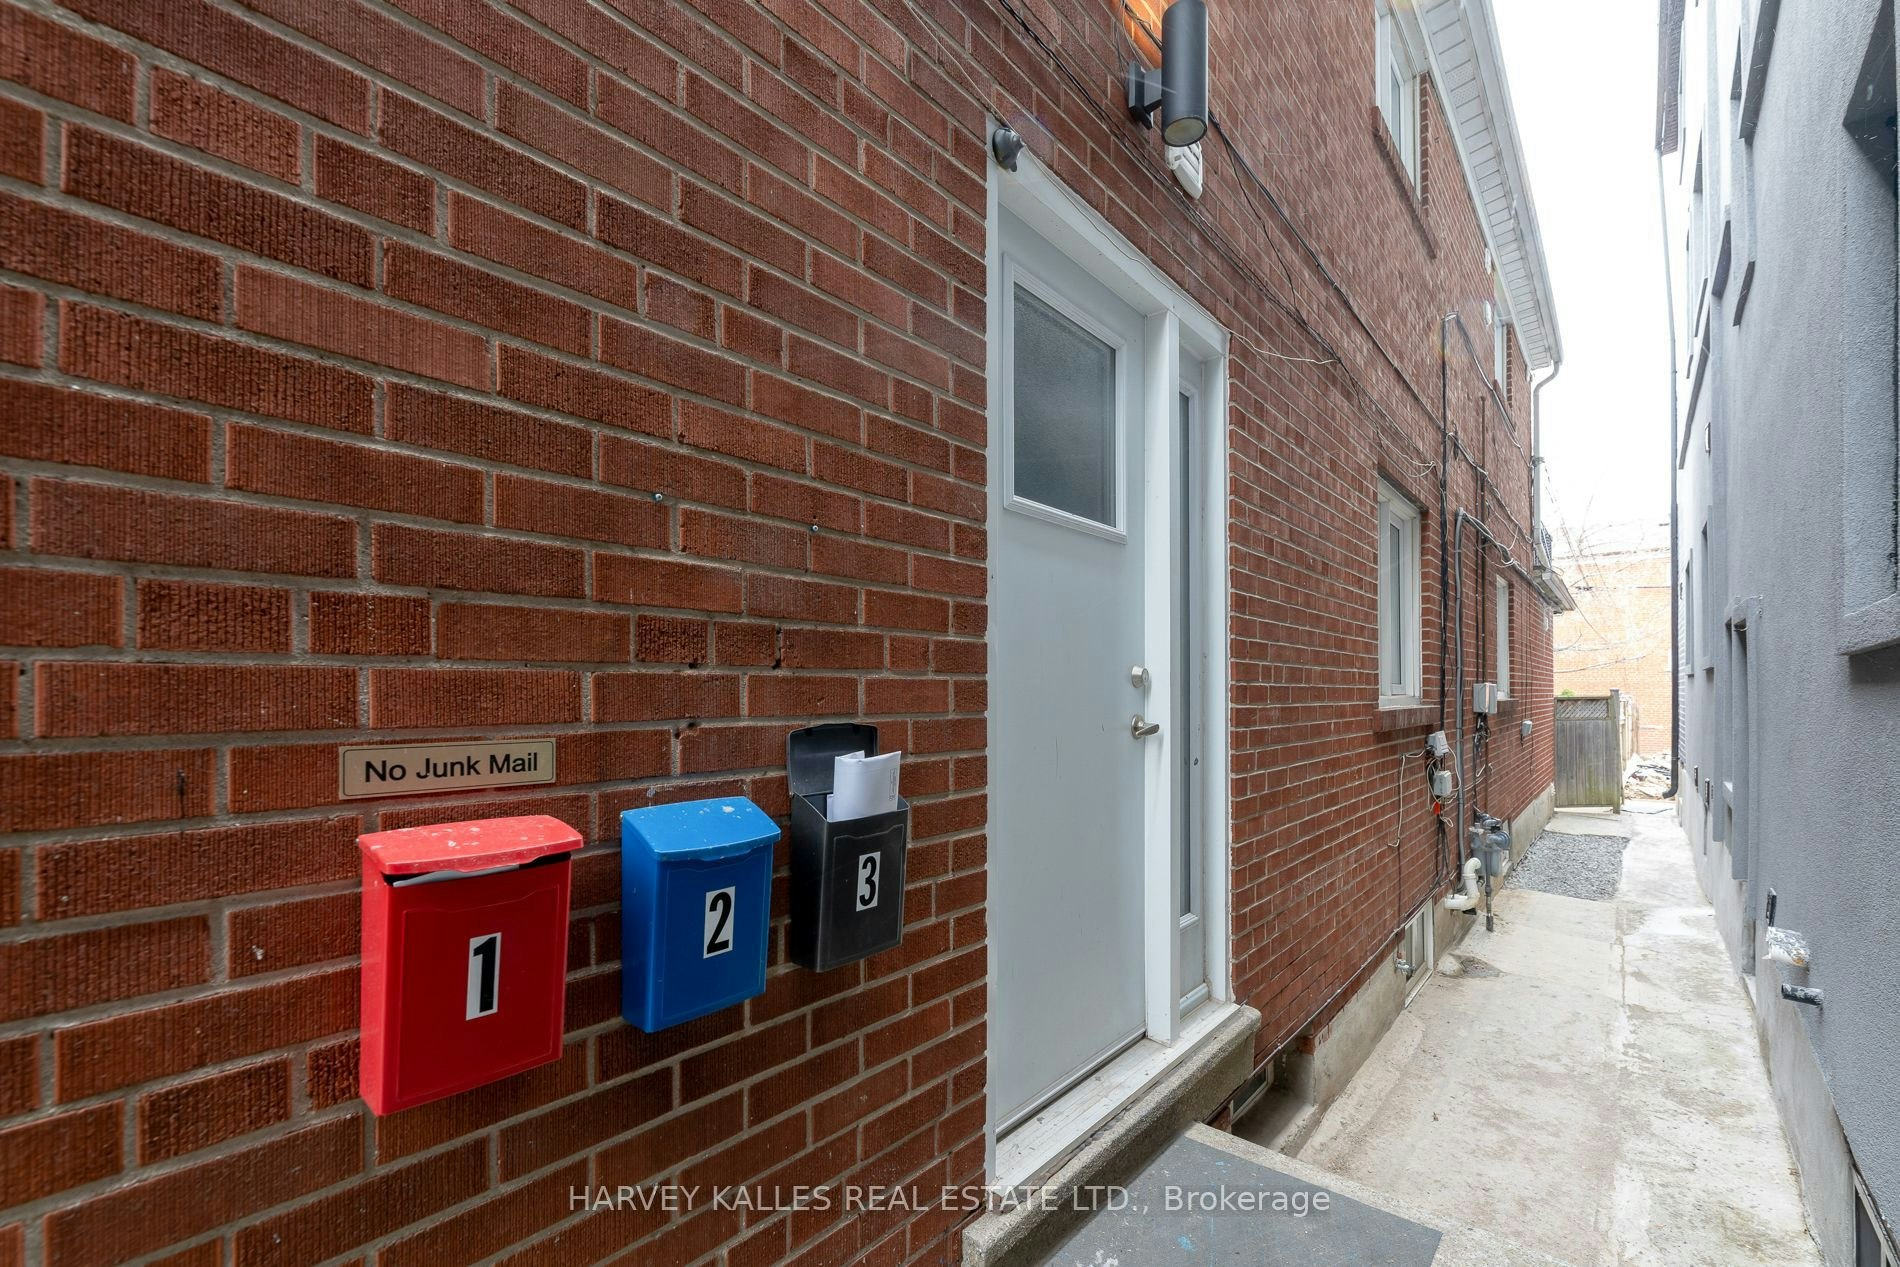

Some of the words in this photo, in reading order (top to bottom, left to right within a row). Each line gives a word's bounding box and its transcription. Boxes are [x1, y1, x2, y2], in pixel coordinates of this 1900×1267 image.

[364, 760, 407, 783] No
[416, 755, 481, 780] Junk
[489, 752, 538, 775] Mail
[858, 855, 878, 907] 3
[705, 890, 732, 956] 2
[472, 935, 498, 1014] 1
